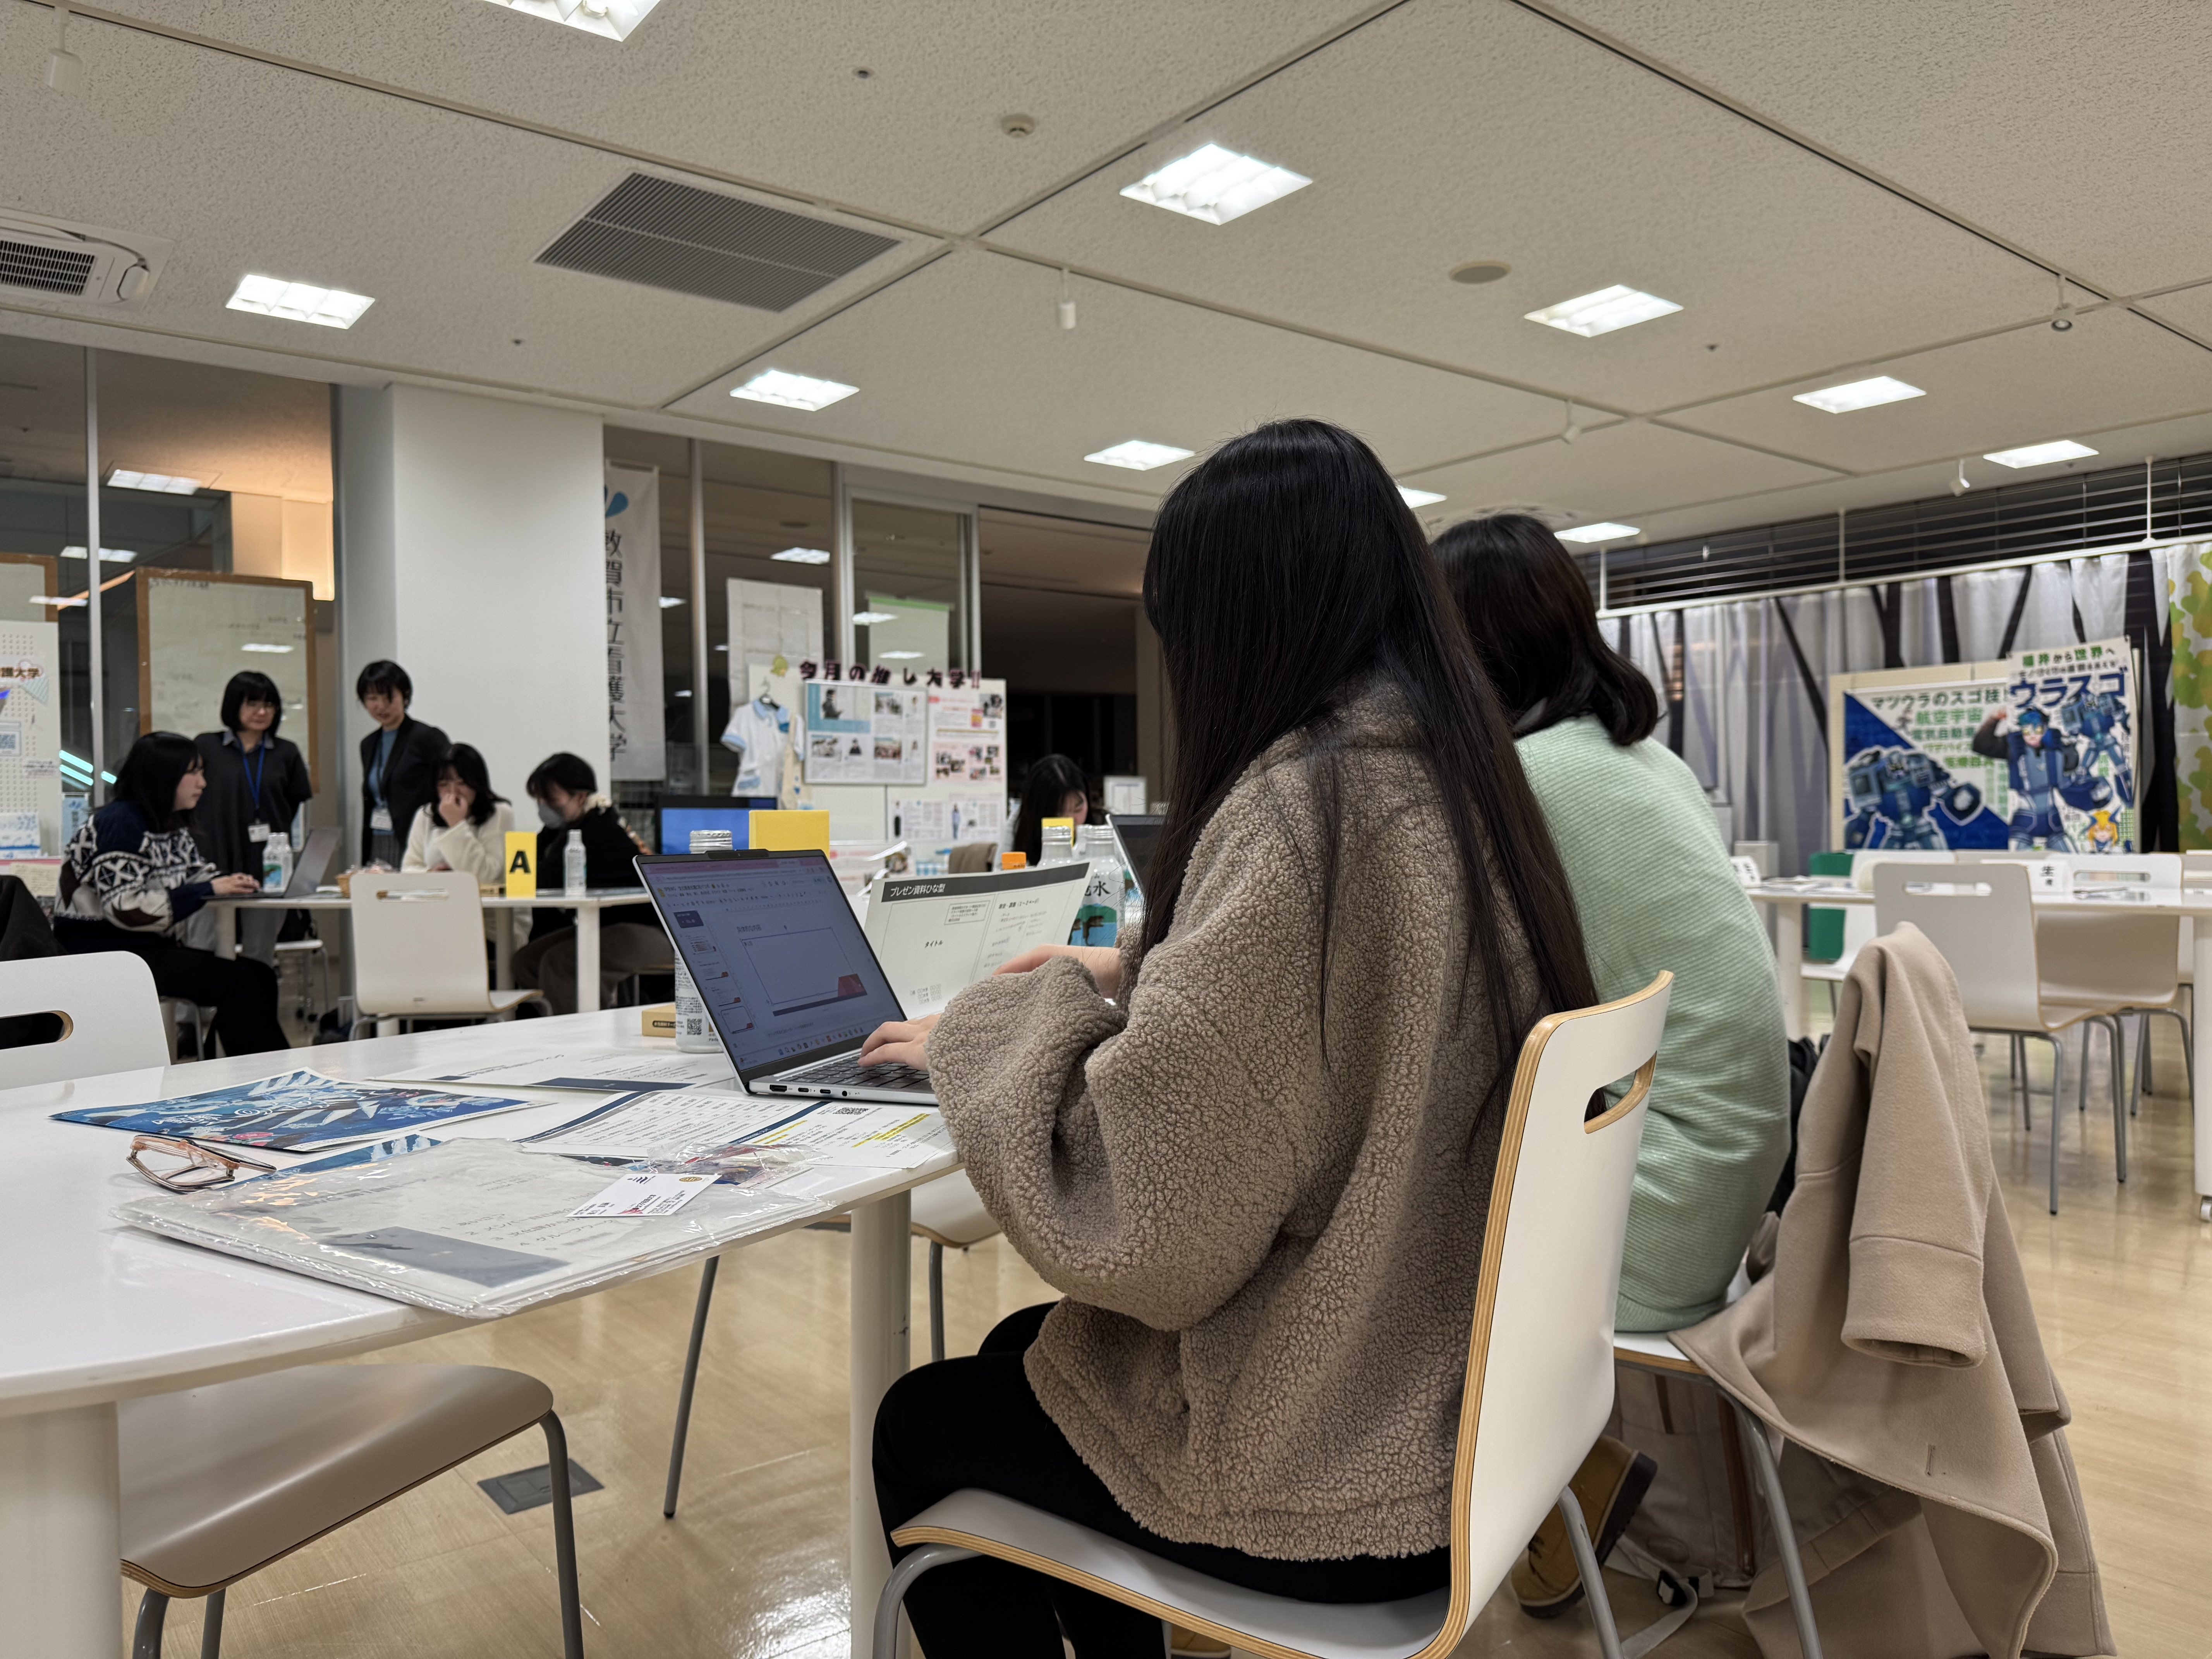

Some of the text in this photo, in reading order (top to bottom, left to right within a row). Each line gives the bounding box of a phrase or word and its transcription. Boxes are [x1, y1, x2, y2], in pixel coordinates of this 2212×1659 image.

[2010, 666, 2128, 708] ウラスゴ
[509, 851, 531, 873] A
[890, 883, 946, 897] プレゼン資料ひな型
[509, 1216, 580, 1237] 文化課からの
